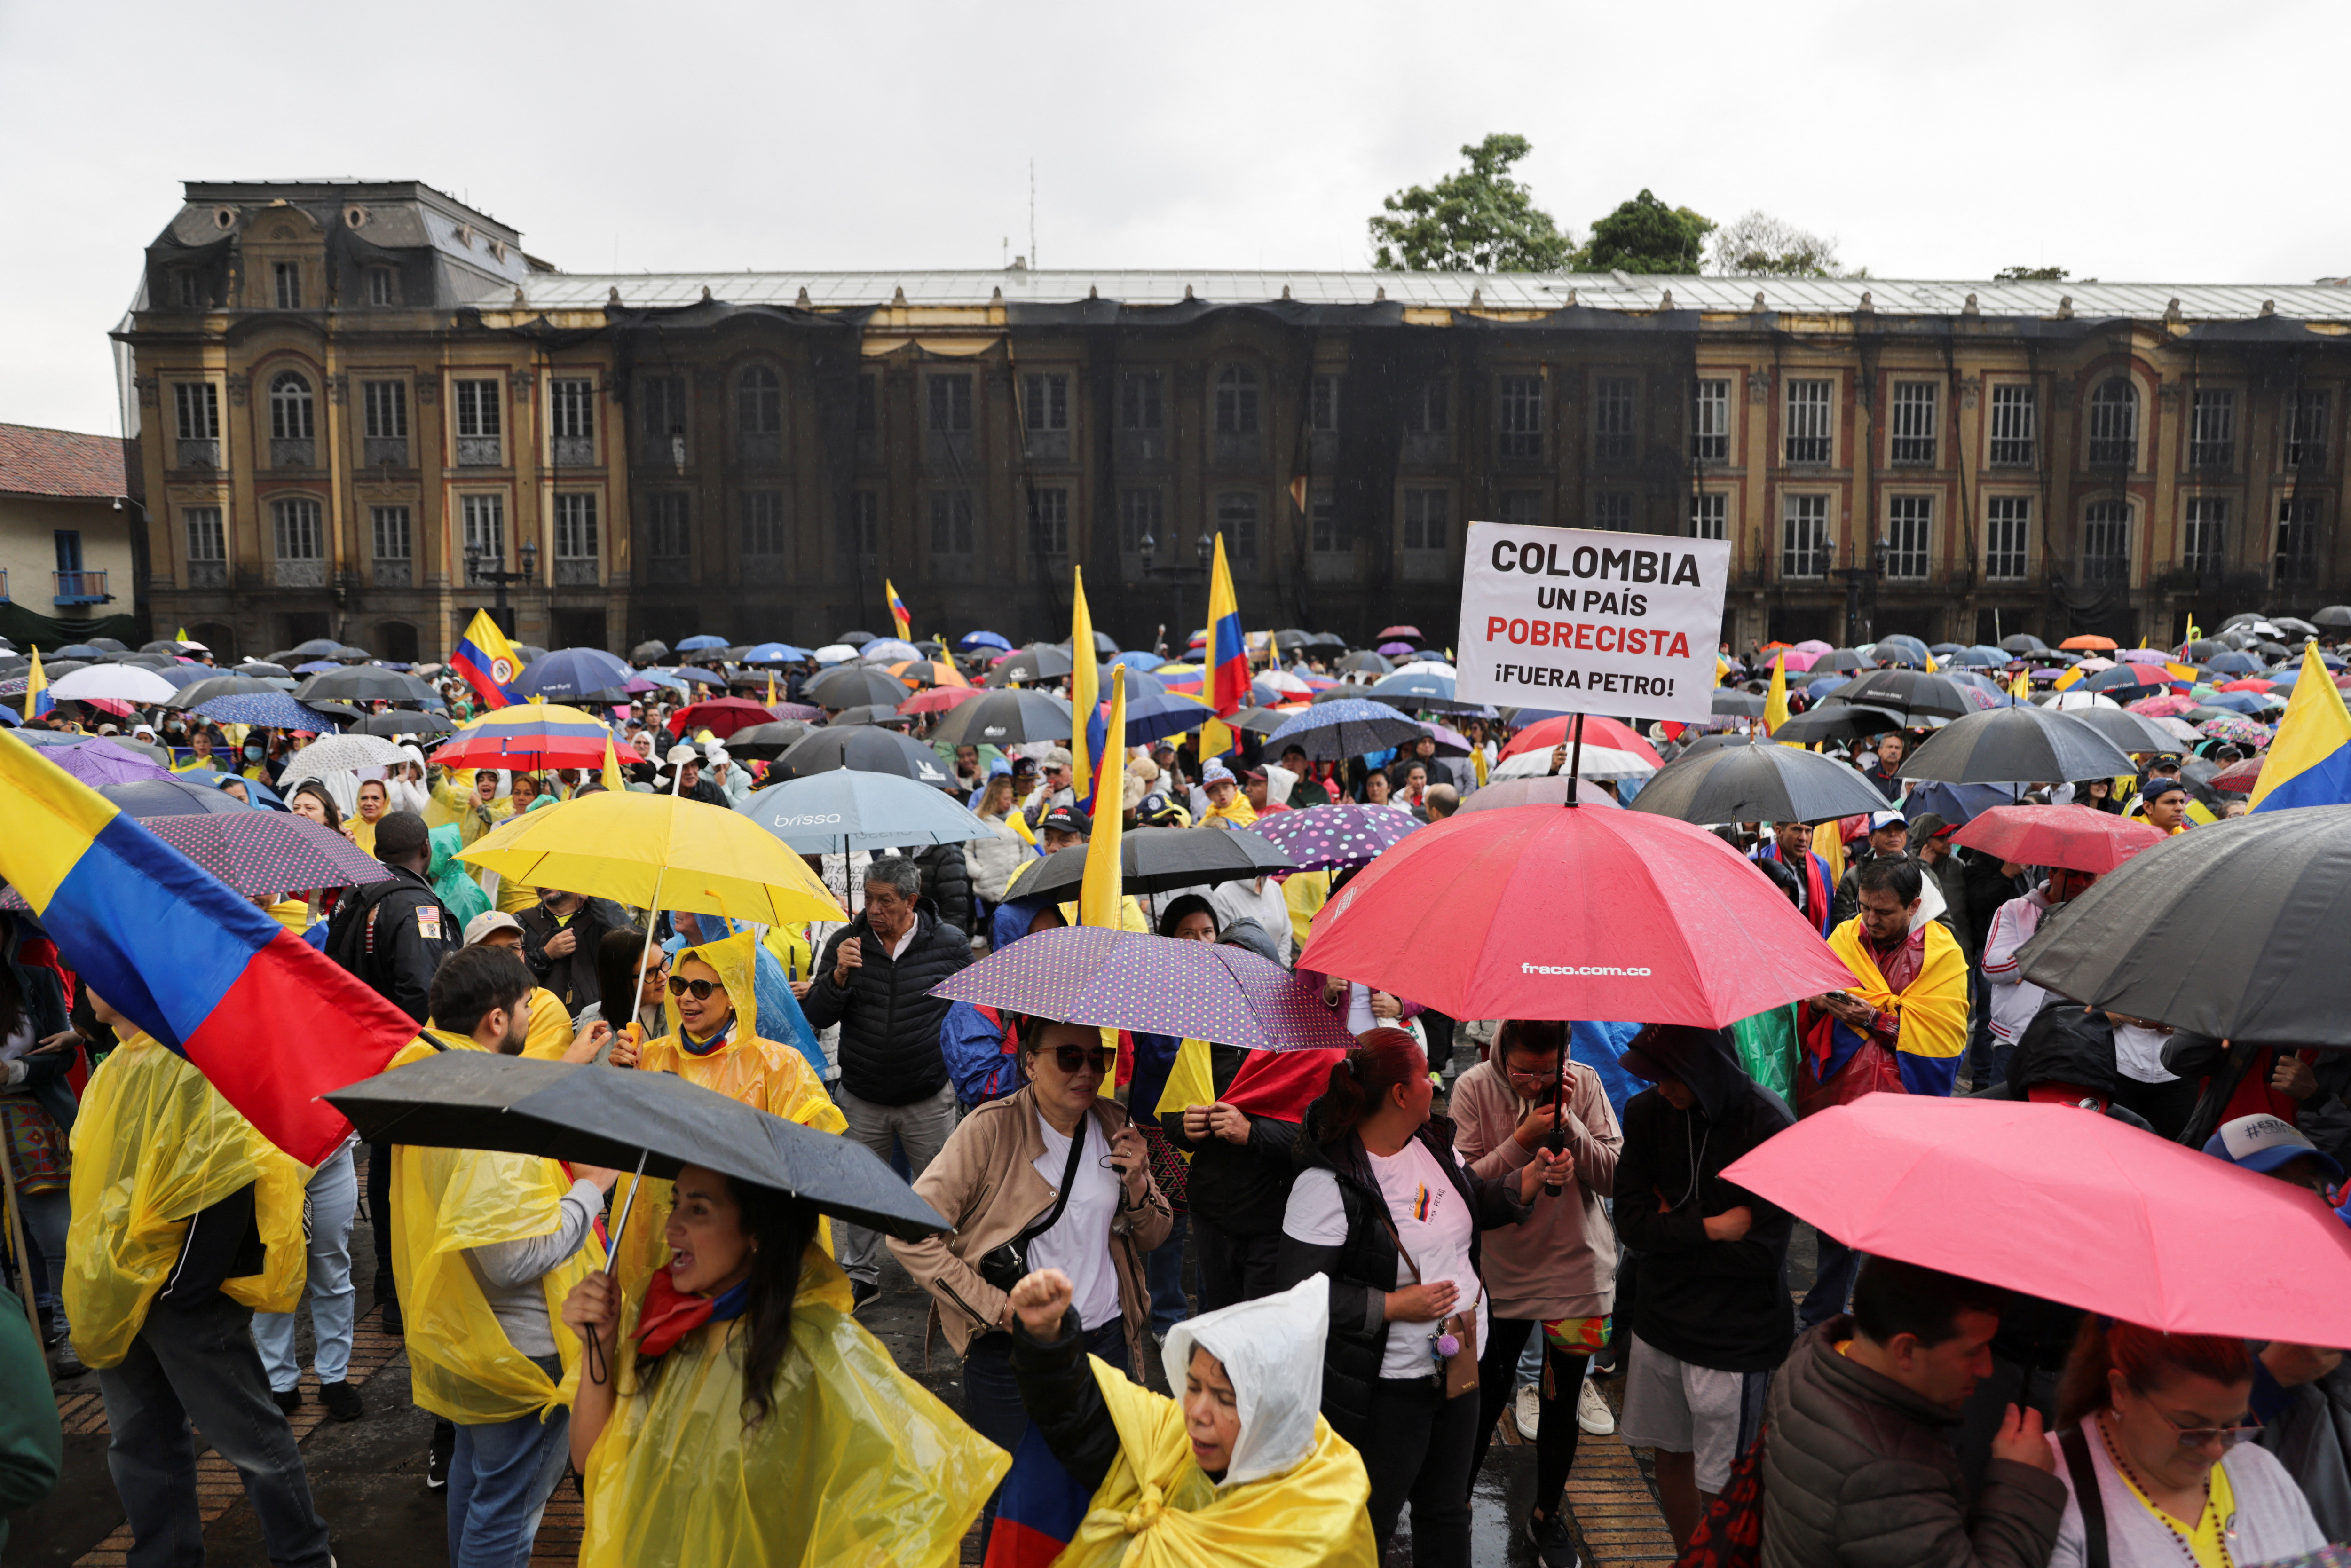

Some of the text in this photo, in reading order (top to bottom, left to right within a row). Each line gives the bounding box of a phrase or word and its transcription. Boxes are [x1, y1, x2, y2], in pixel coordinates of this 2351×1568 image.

[1491, 540, 1701, 587] COLOMBIA
[1538, 587, 1648, 616] UN PAÍS
[1486, 616, 1690, 658] POBRECISTA
[1495, 663, 1674, 697] ¡FUERA PETRO!
[774, 813, 841, 827] brissa
[1521, 962, 1651, 976] fraco.com.co
